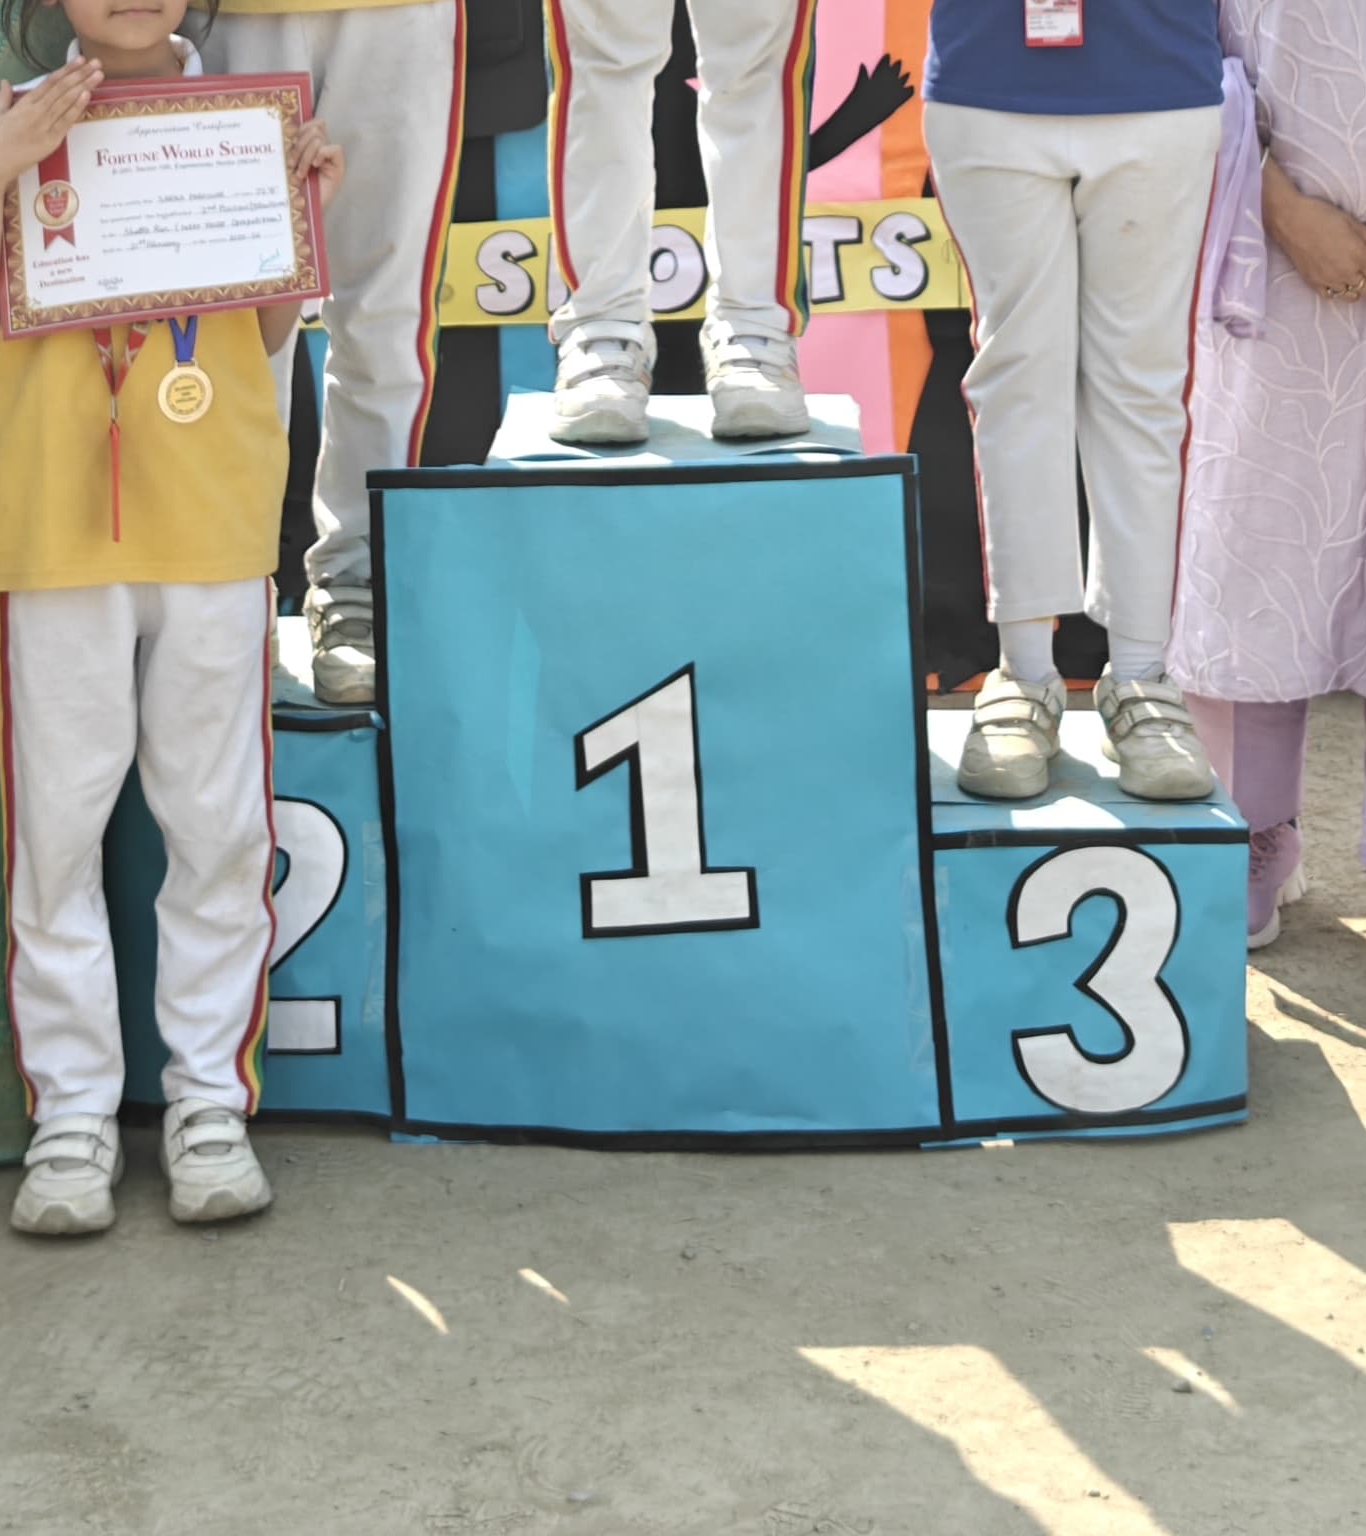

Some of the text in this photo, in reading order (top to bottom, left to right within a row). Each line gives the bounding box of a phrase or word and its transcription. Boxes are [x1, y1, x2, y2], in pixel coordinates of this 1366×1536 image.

[95, 140, 276, 167] FORTUNE WORLD SCHOOL
[475, 212, 932, 315] SOTS
[573, 661, 760, 940] 1
[1005, 840, 1191, 1115] 3
